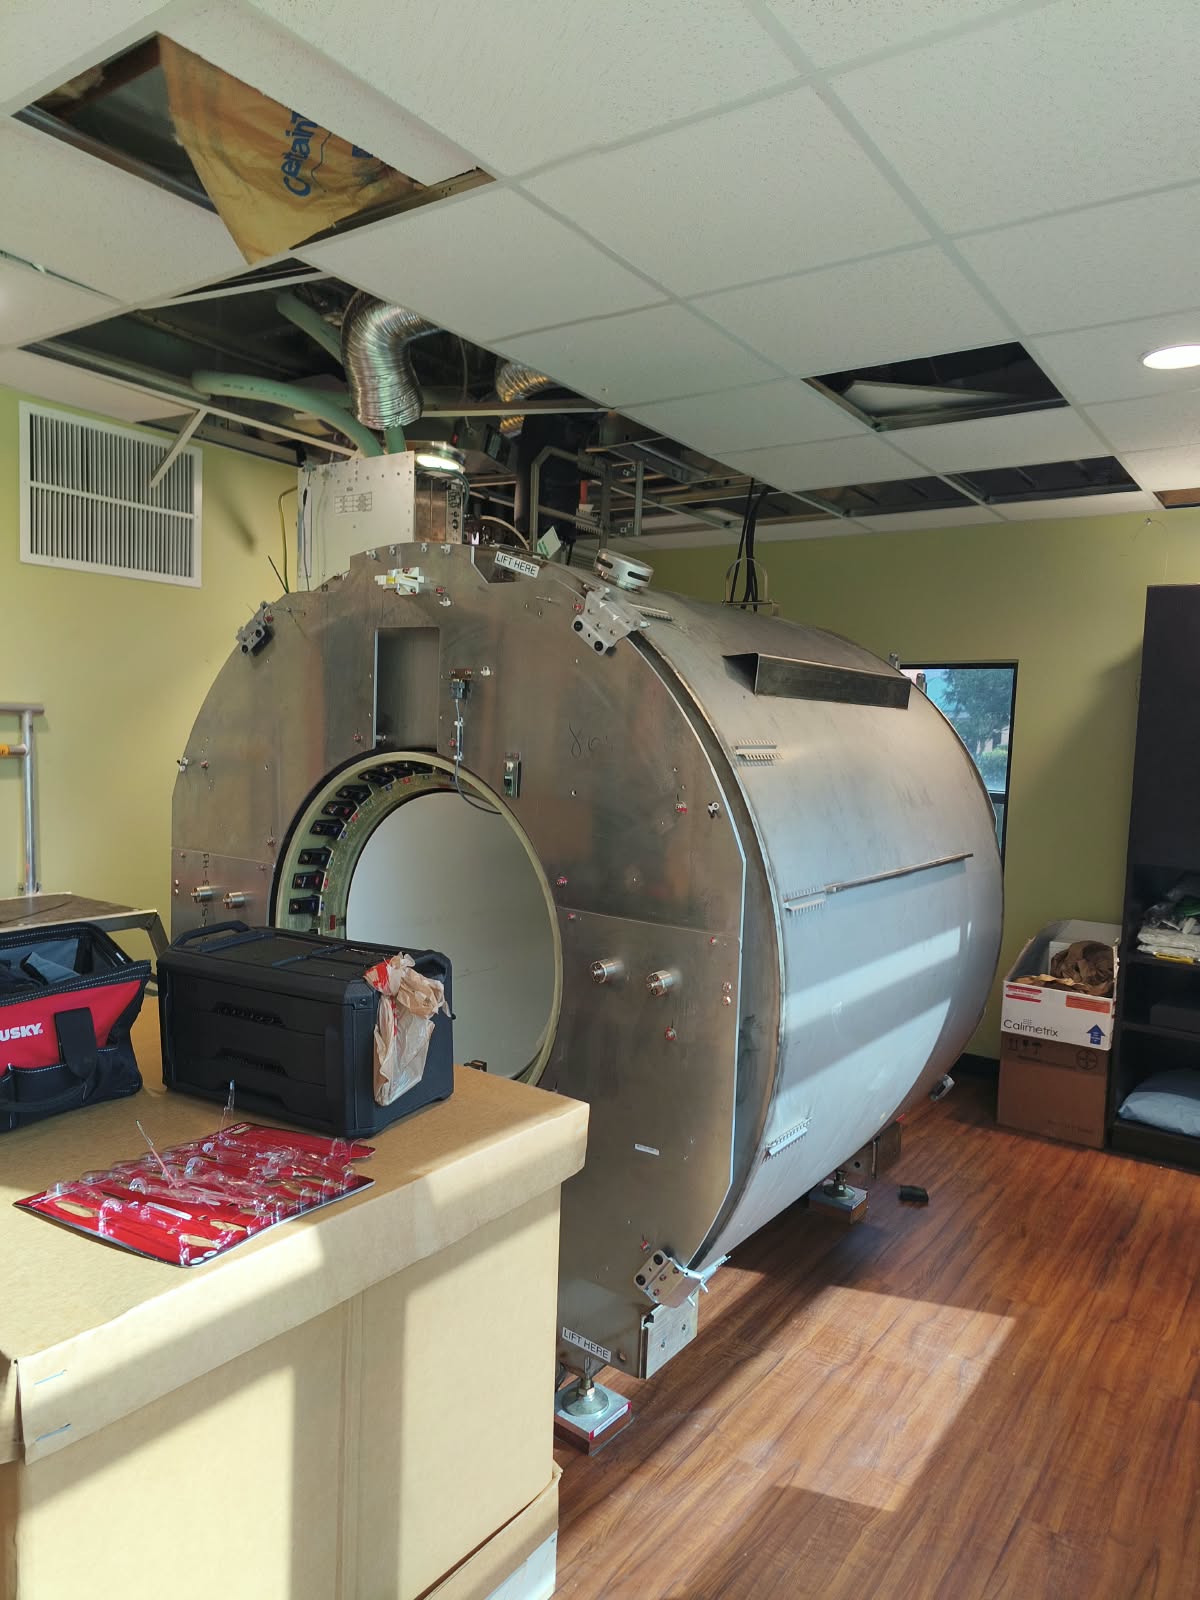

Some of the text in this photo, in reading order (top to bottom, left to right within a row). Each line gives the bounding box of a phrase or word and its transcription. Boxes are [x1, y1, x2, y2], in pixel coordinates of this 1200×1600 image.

[496, 552, 537, 575] LIFT HERE
[1003, 1019, 1059, 1038] Calimetrix
[563, 1328, 609, 1359] LIFT HERE
